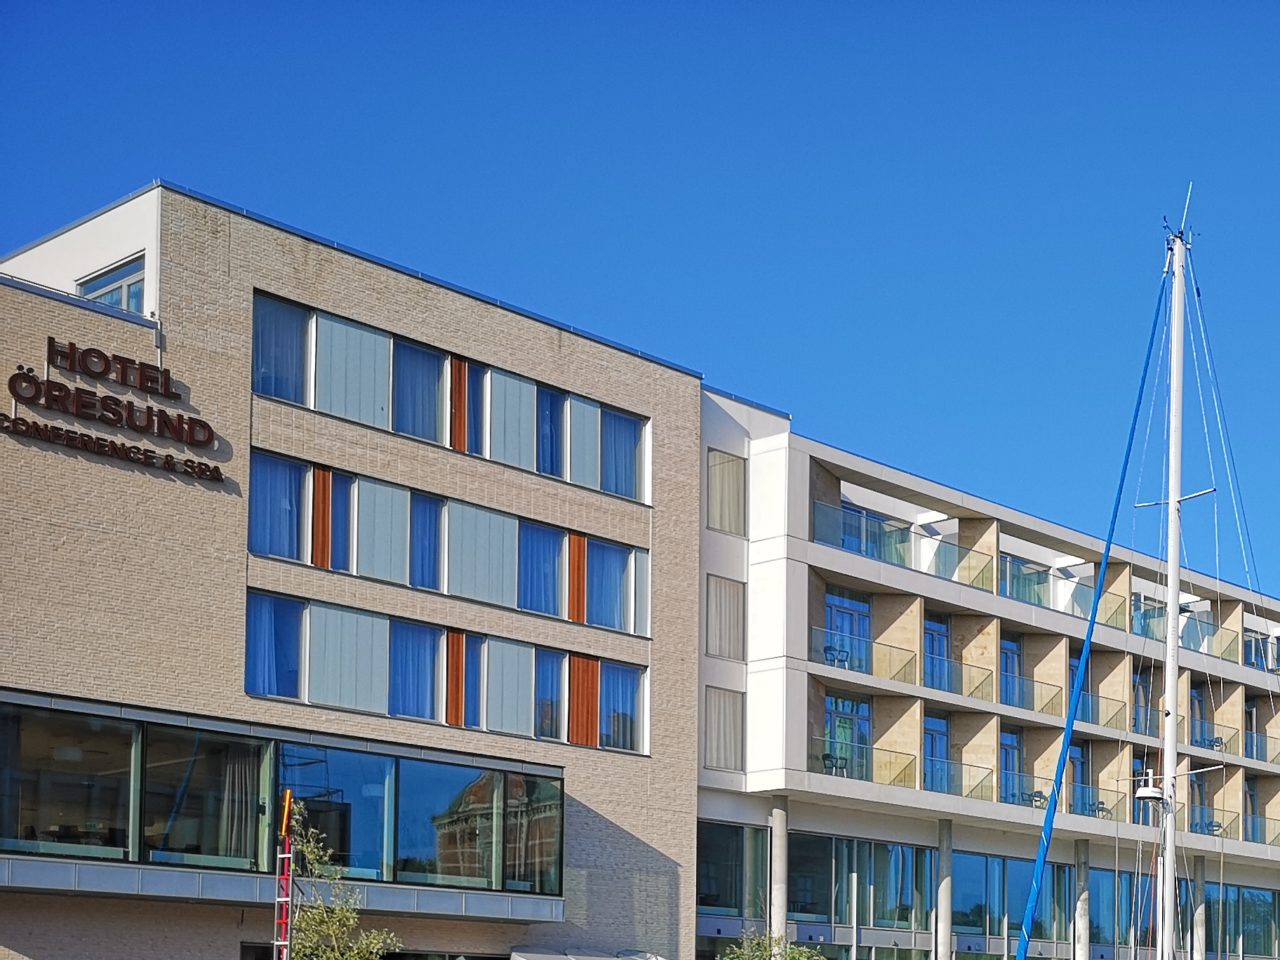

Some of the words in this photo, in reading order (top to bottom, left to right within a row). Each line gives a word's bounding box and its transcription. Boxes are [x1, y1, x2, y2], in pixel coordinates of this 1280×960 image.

[48, 336, 181, 399] HOTEL
[8, 365, 214, 446] ÖRESUND
[164, 455, 174, 472] &
[183, 459, 224, 482] SPA
